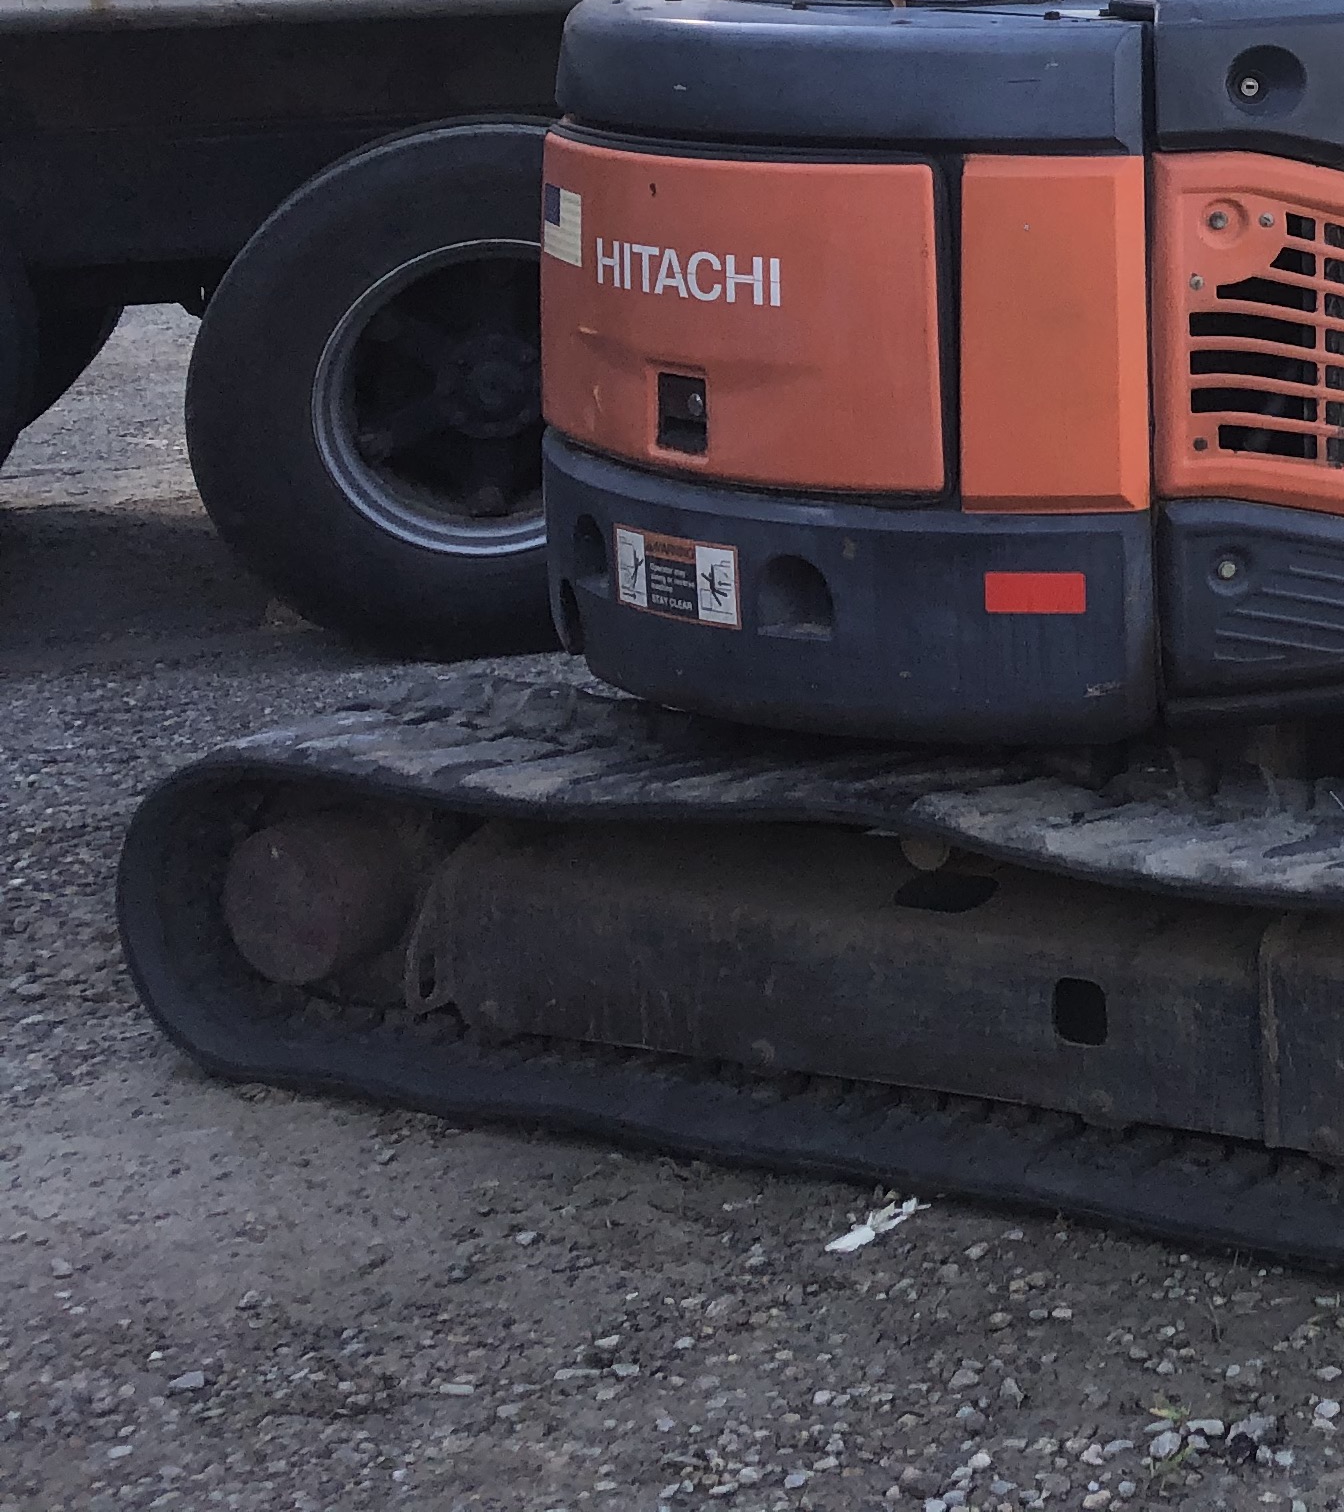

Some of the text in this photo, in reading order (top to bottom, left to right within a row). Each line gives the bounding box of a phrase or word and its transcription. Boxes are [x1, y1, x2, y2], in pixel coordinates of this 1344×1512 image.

[596, 237, 781, 307] HITACHI
[651, 594, 693, 611] STAY CLEAR
